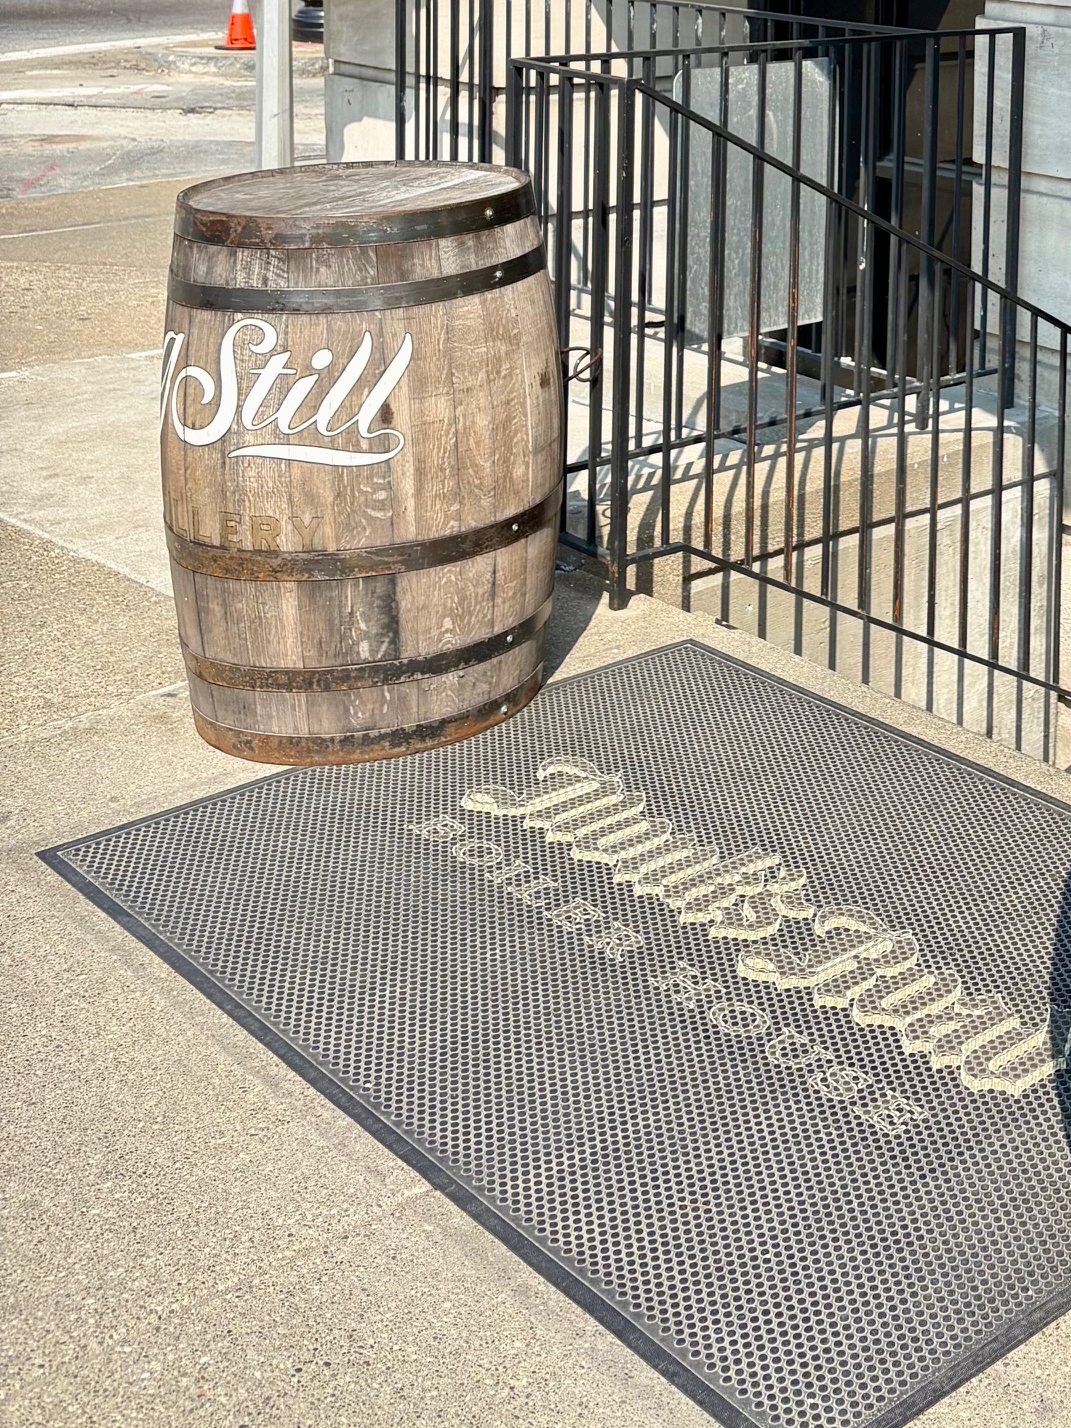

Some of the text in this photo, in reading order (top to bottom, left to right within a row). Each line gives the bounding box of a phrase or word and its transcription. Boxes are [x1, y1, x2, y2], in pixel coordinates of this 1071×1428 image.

[171, 318, 412, 467] Still
[403, 814, 643, 961] BOILER
[460, 756, 814, 940] Monk's
[649, 960, 928, 1135] HOUSE
